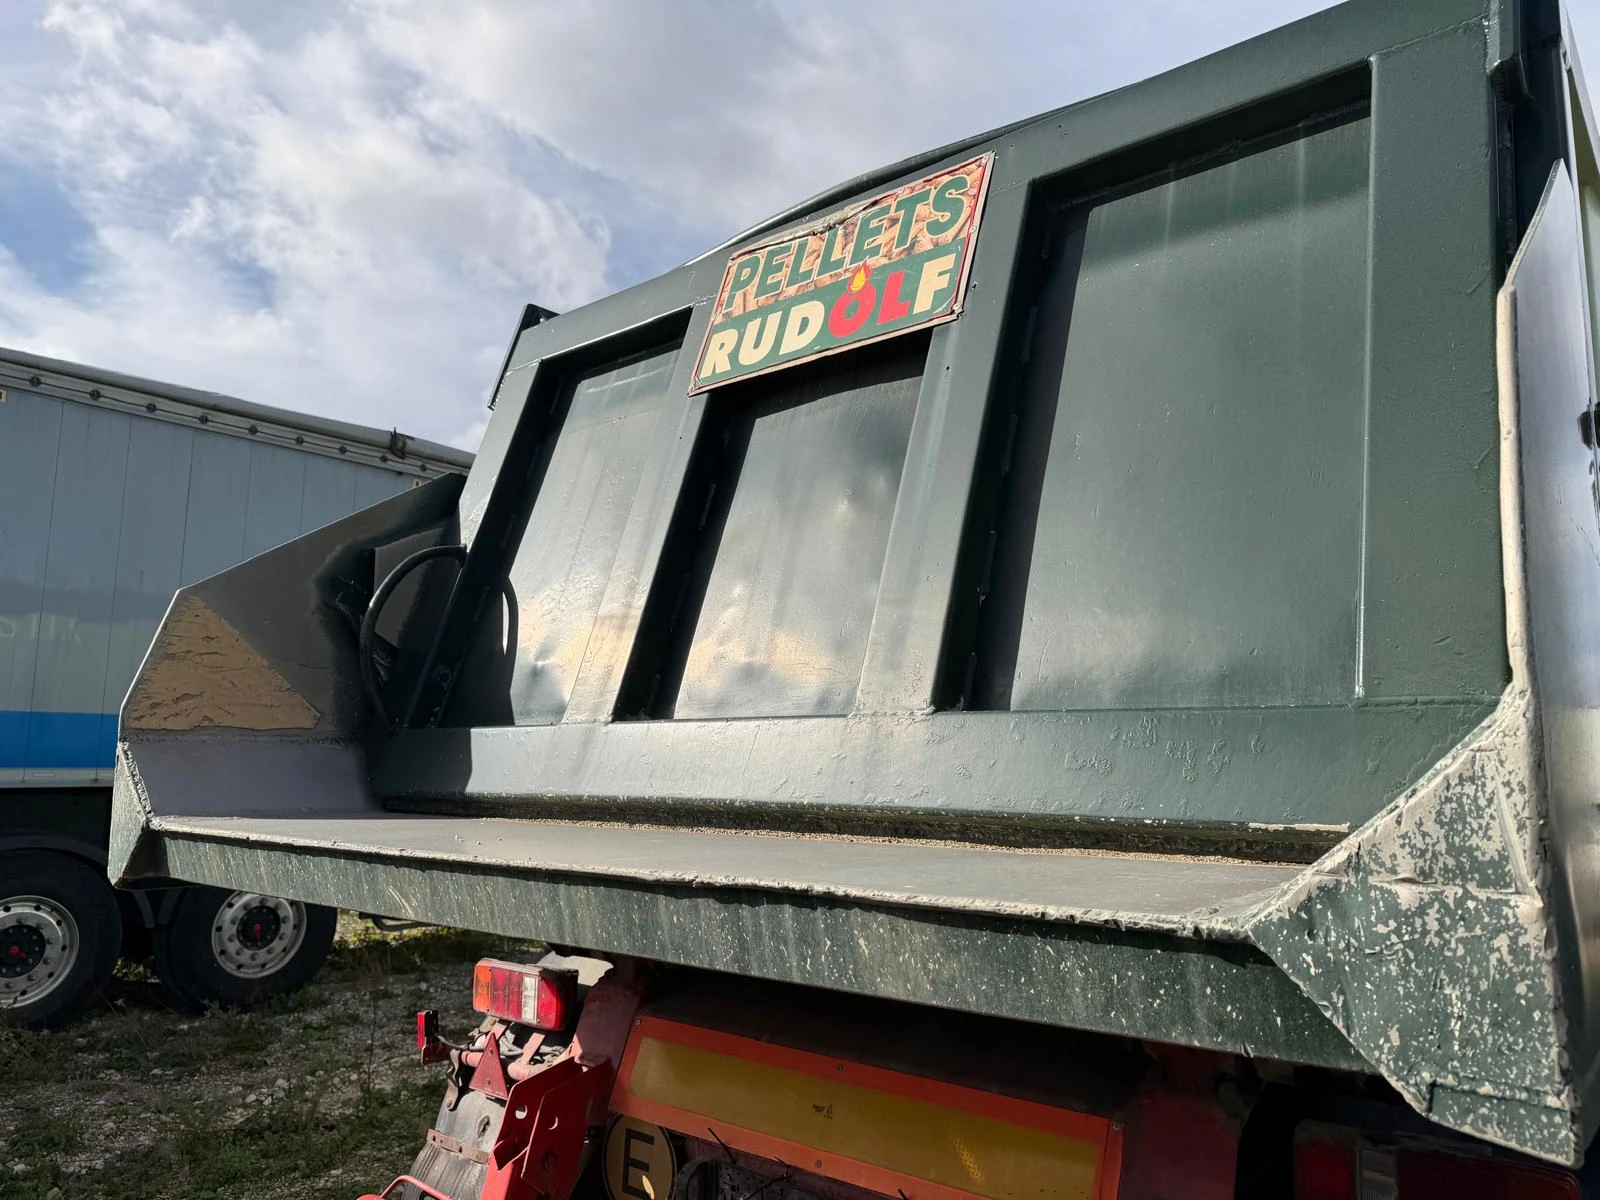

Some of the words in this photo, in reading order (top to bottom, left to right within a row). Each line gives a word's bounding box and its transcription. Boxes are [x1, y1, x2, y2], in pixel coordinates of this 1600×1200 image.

[721, 174, 970, 314] PELLETS
[699, 253, 957, 379] RUDOLF
[622, 1127, 655, 1200] E
